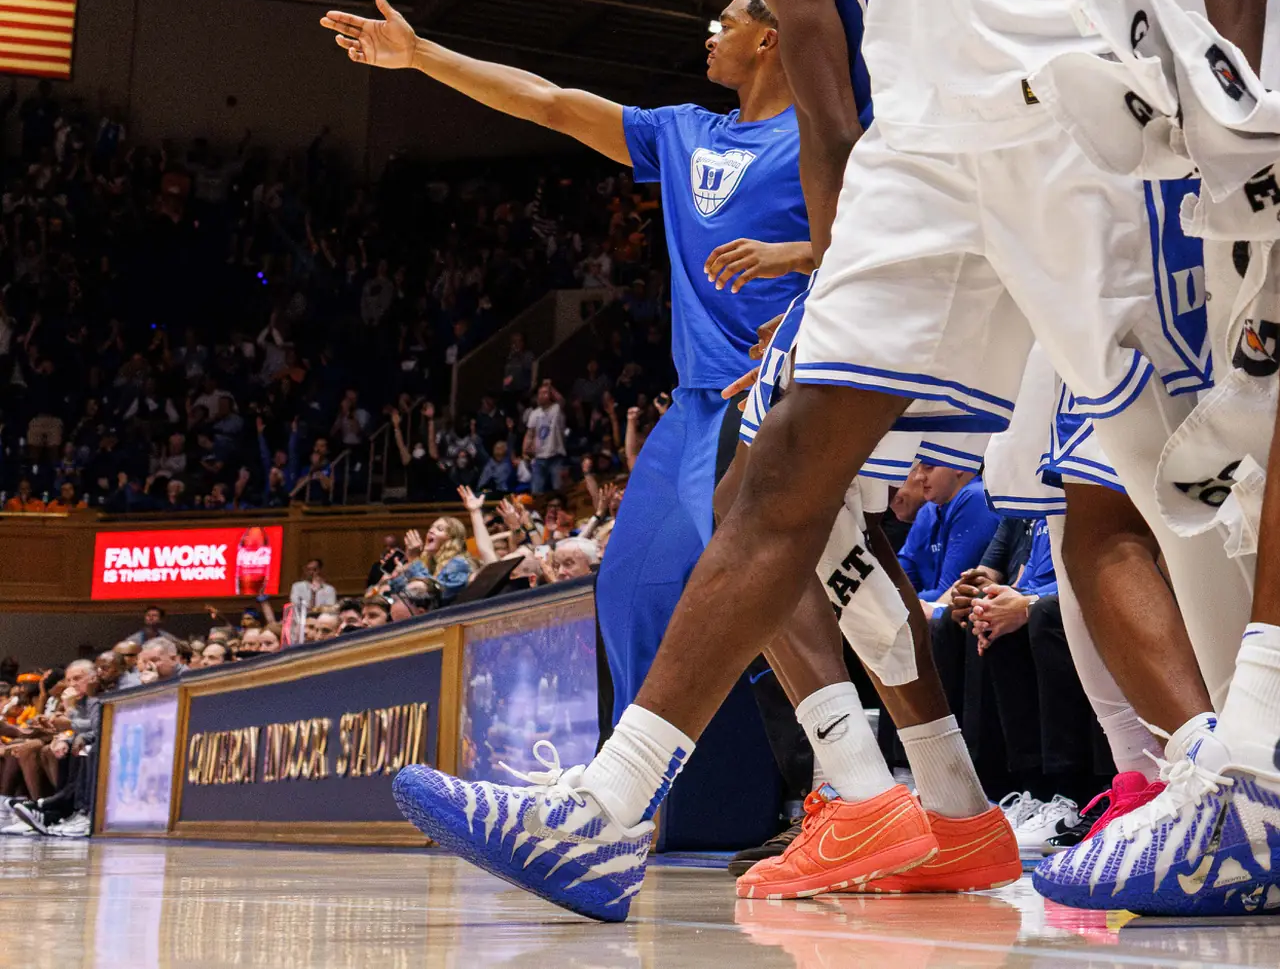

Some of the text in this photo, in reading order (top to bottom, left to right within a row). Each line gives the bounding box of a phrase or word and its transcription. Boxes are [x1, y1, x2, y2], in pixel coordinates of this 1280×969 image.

[104, 543, 229, 569] FAN WORK
[103, 565, 226, 583] IS THIRSTY WORK
